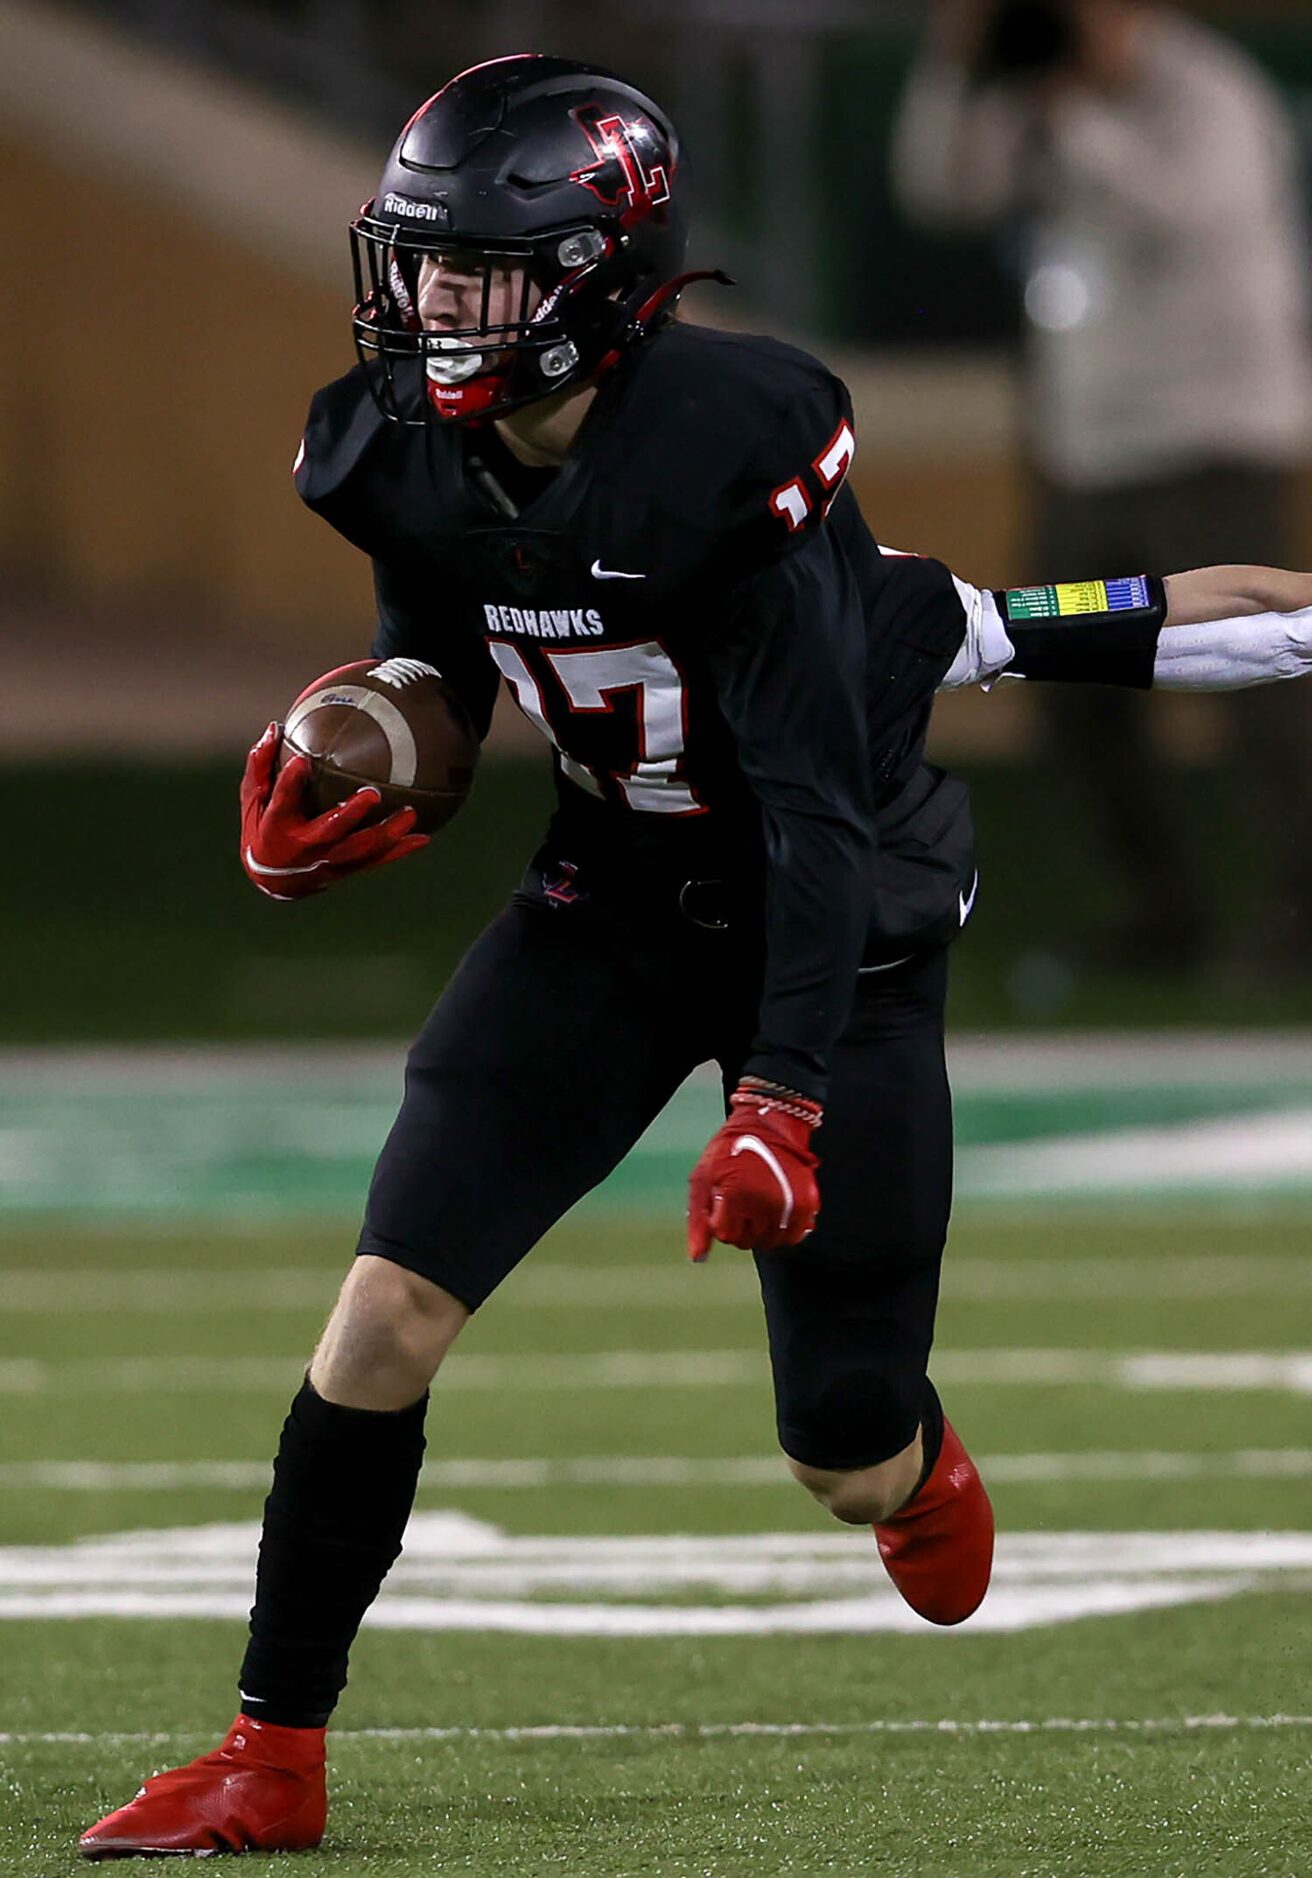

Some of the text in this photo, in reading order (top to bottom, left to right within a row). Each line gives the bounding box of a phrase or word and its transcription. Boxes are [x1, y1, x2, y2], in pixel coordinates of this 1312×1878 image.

[384, 192, 438, 220] Riddell
[483, 604, 605, 639] REDHAWKS
[484, 636, 710, 818] 17
